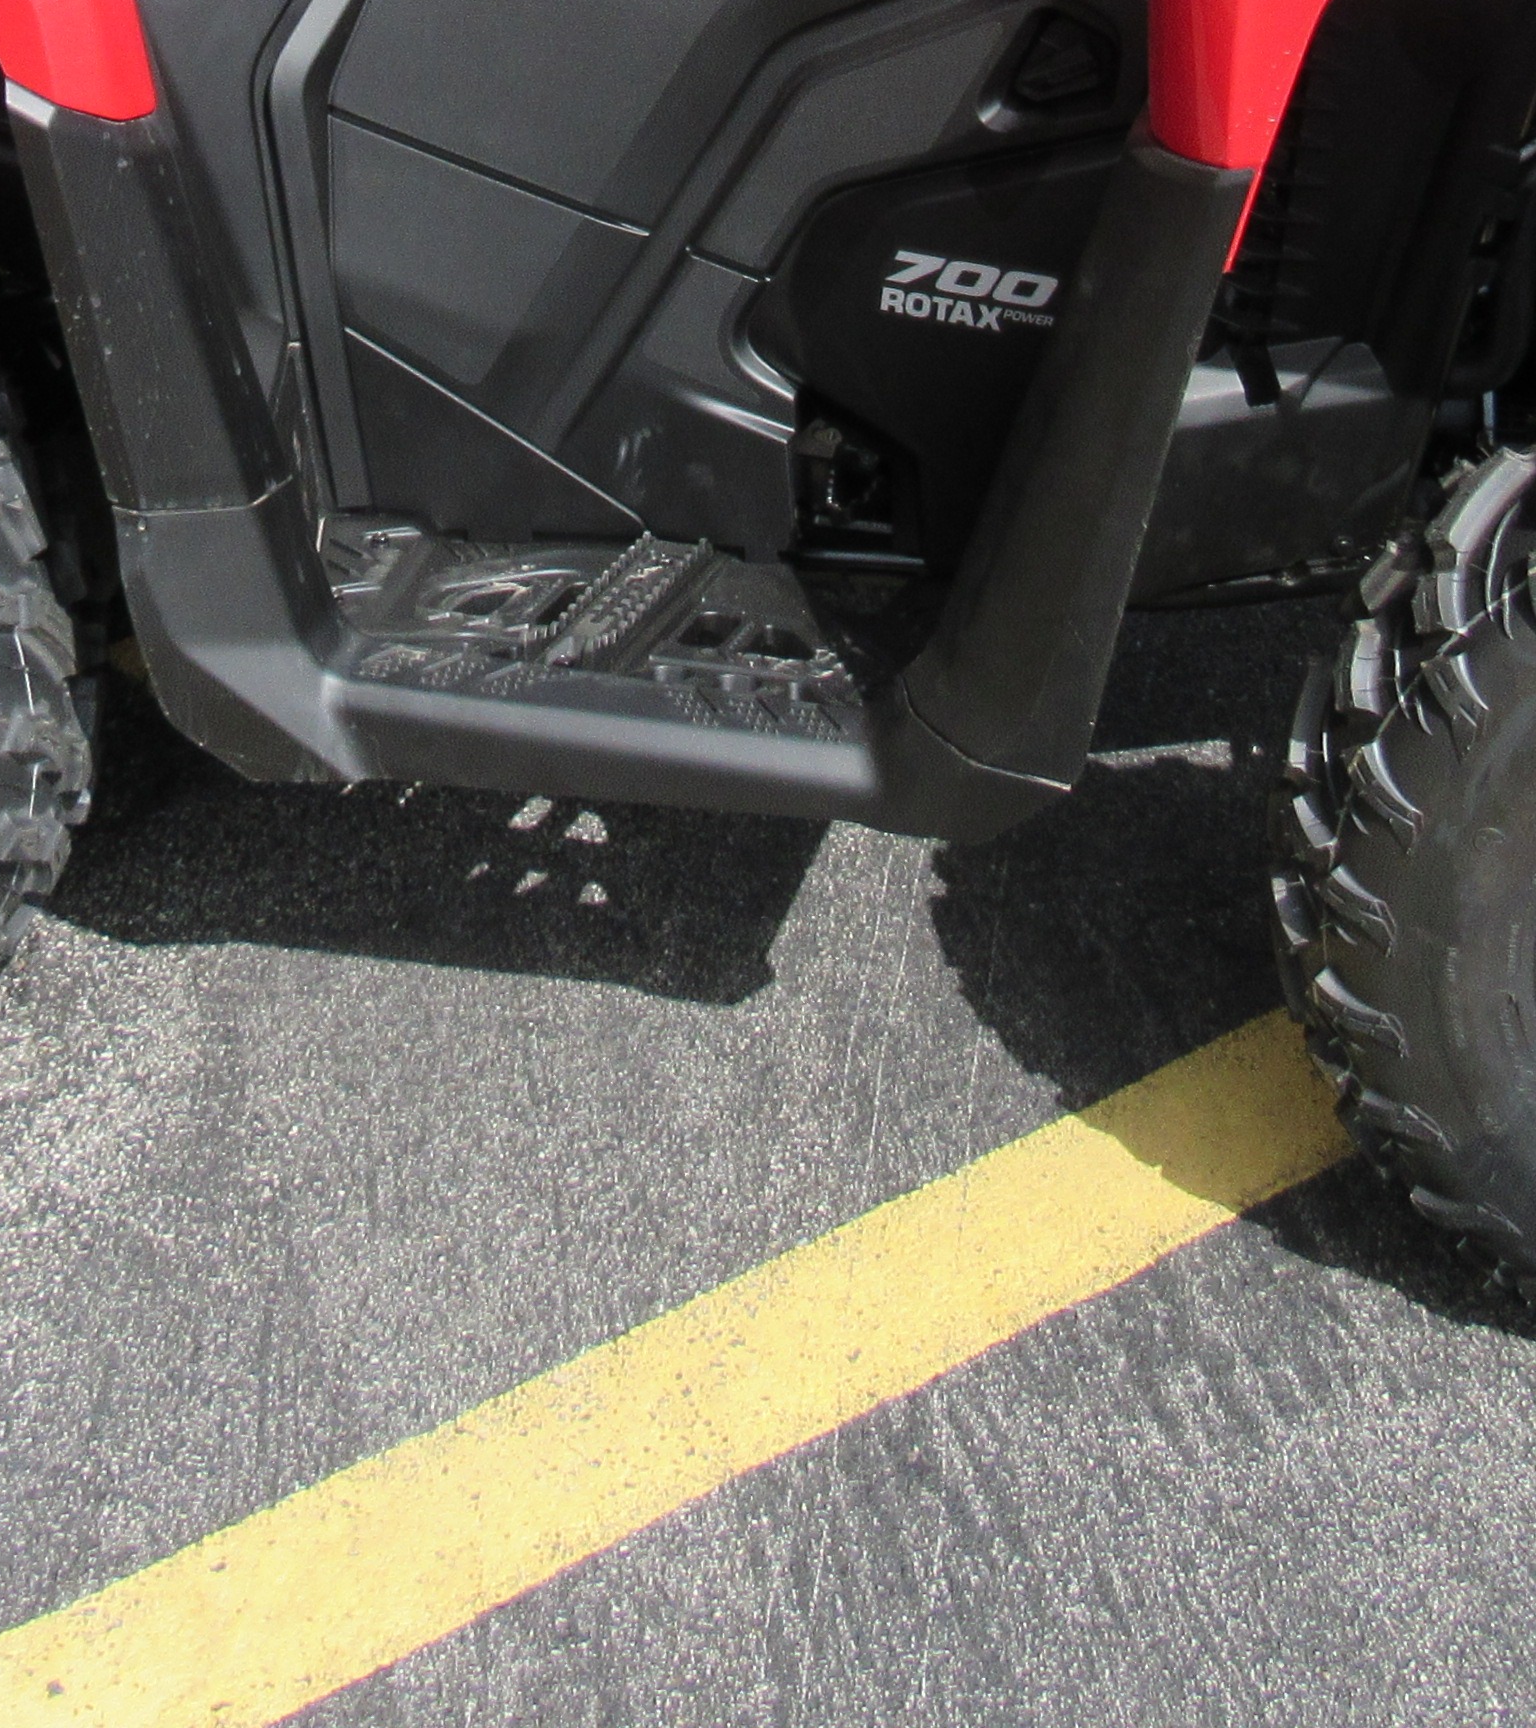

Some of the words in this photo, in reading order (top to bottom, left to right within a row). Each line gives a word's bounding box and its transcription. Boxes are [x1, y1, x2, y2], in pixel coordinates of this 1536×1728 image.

[884, 250, 1059, 308] 700
[879, 286, 1002, 332] ROTAX
[1003, 308, 1055, 327] POWER
